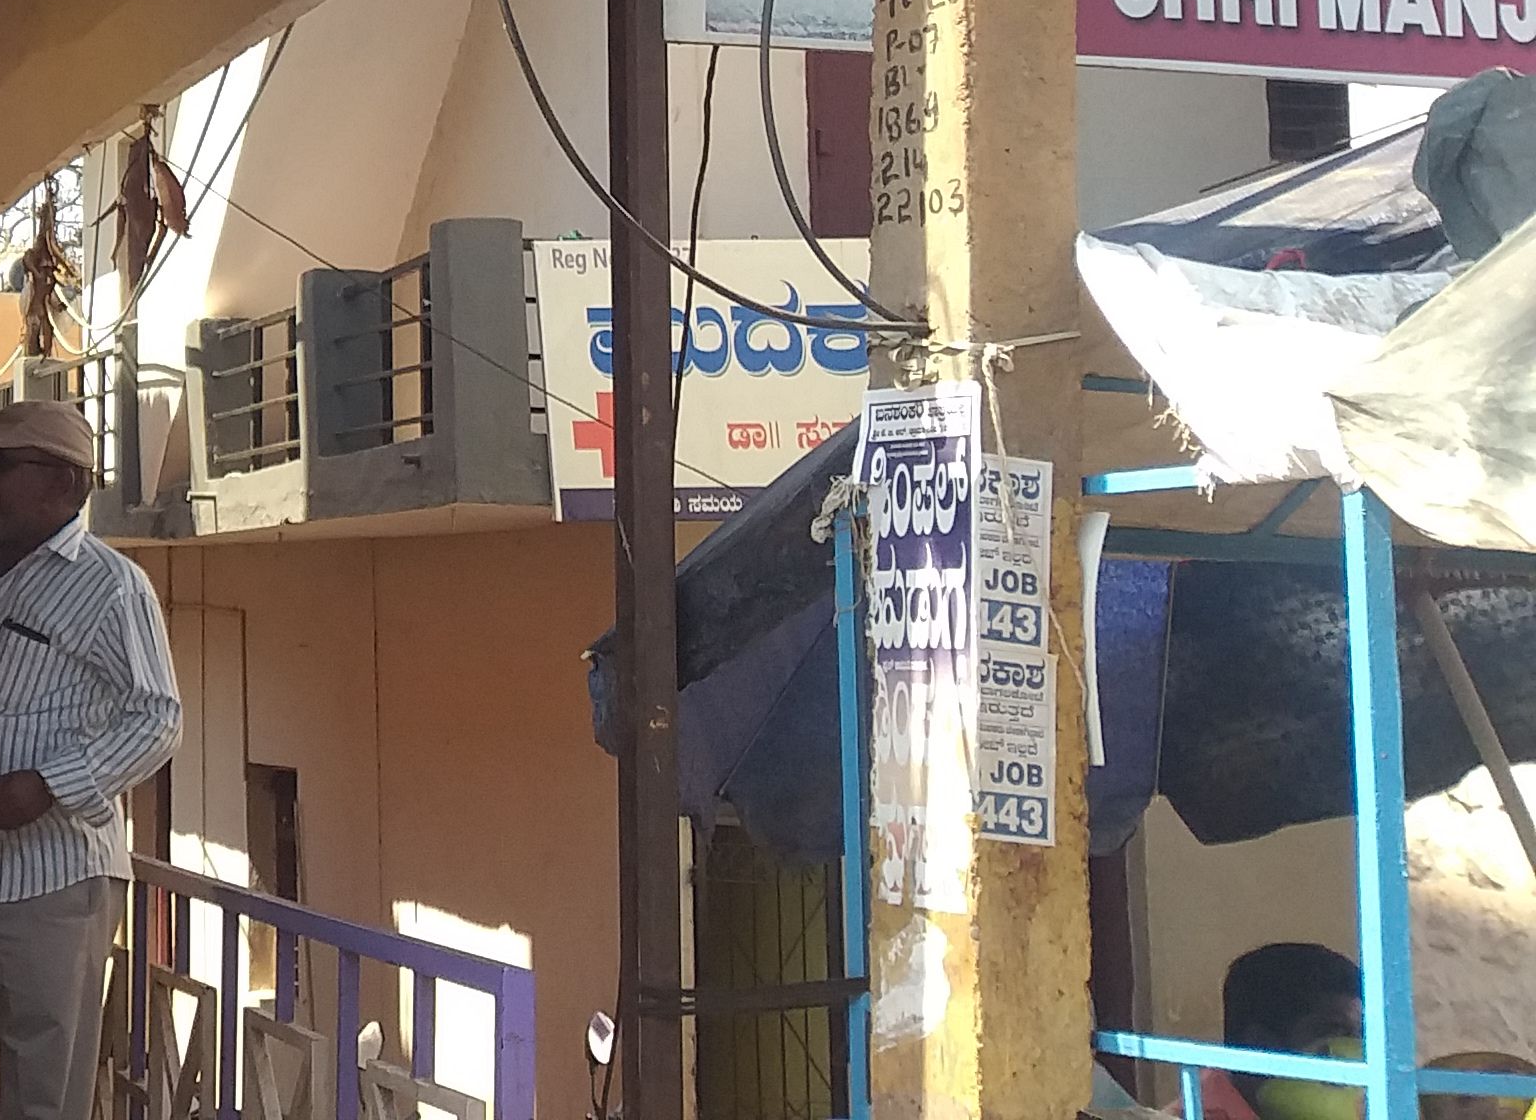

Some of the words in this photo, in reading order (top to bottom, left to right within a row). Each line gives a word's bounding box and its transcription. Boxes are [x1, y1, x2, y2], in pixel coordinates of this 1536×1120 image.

[551, 247, 587, 274] Reg
[985, 568, 1038, 596] JOB
[990, 760, 1044, 788] JOB
